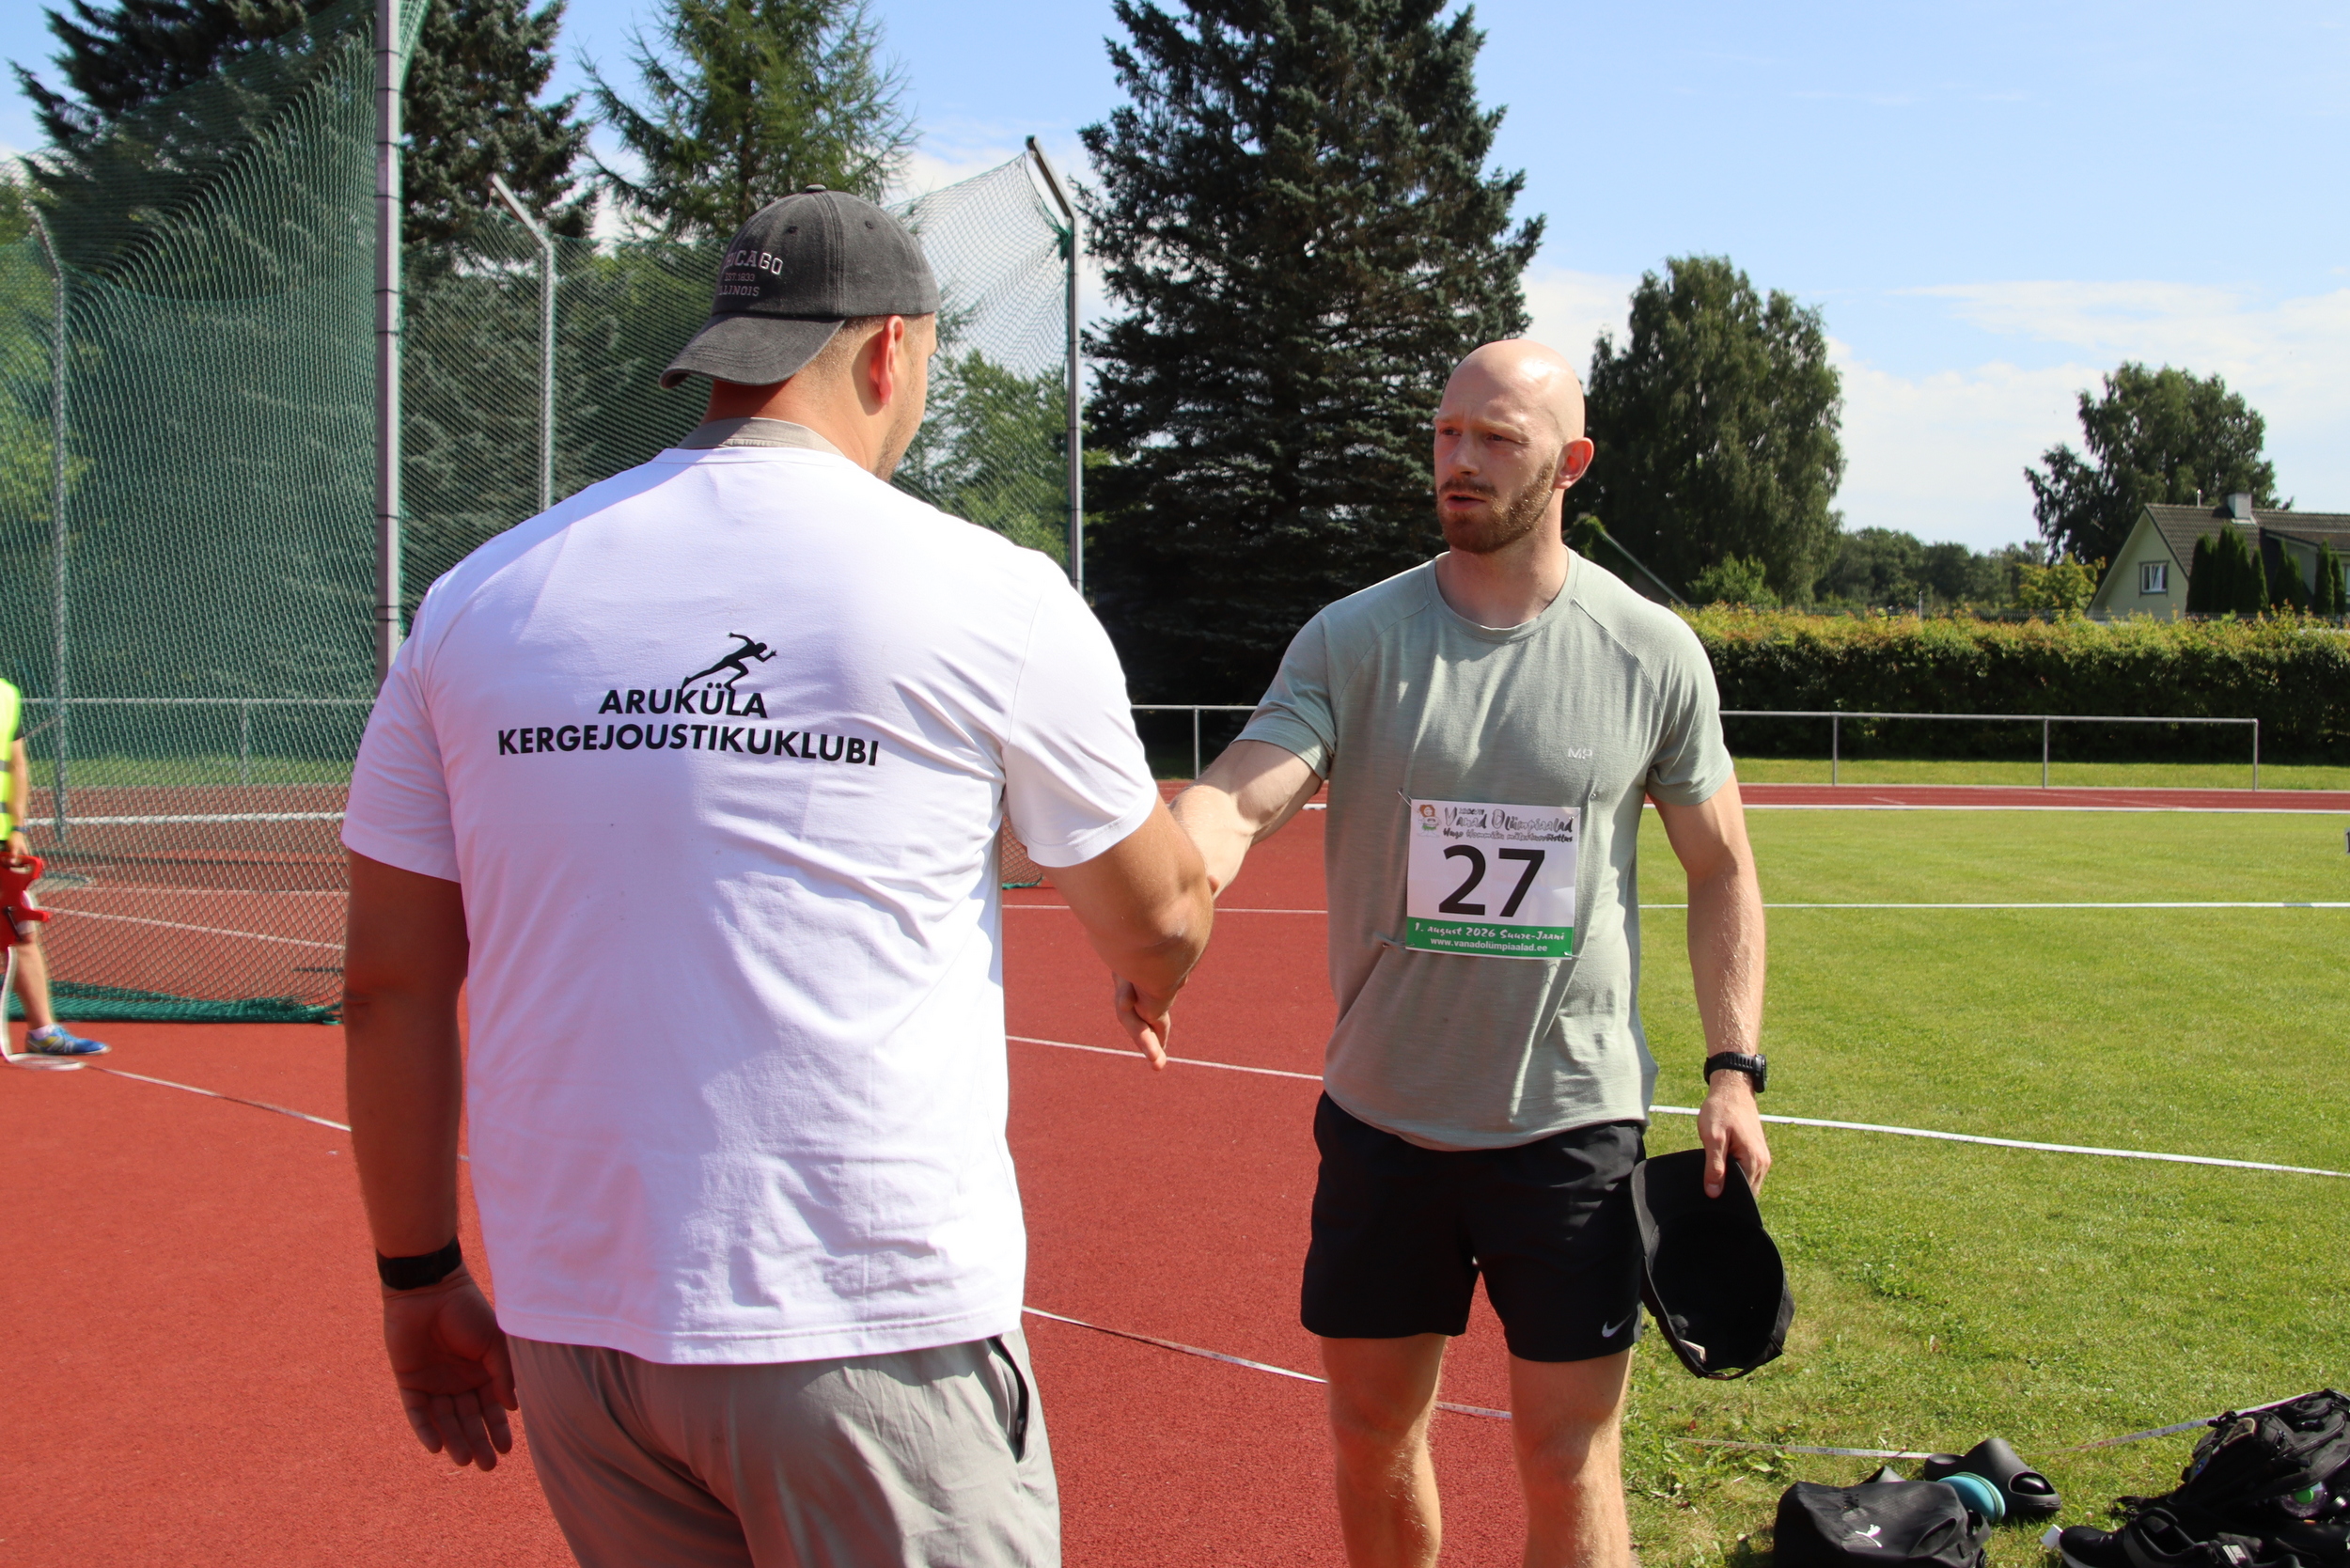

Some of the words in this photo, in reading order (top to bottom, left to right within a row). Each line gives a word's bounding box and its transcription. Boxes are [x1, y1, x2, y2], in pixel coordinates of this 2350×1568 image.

[722, 250, 784, 275] HICAGO
[598, 682, 769, 719] ARUKÜLA
[497, 723, 880, 766] KERGEJOUSTIKUKLUBI
[1444, 807, 1488, 829] Vanad
[1438, 844, 1545, 917] 27
[1414, 922, 1424, 933] 1.
[1427, 924, 1463, 937] august
[1465, 926, 1496, 938] 2026
[1499, 928, 1566, 942] Suure-Jaani
[1430, 937, 1548, 952] www.vanadolümpiaalad.ee
